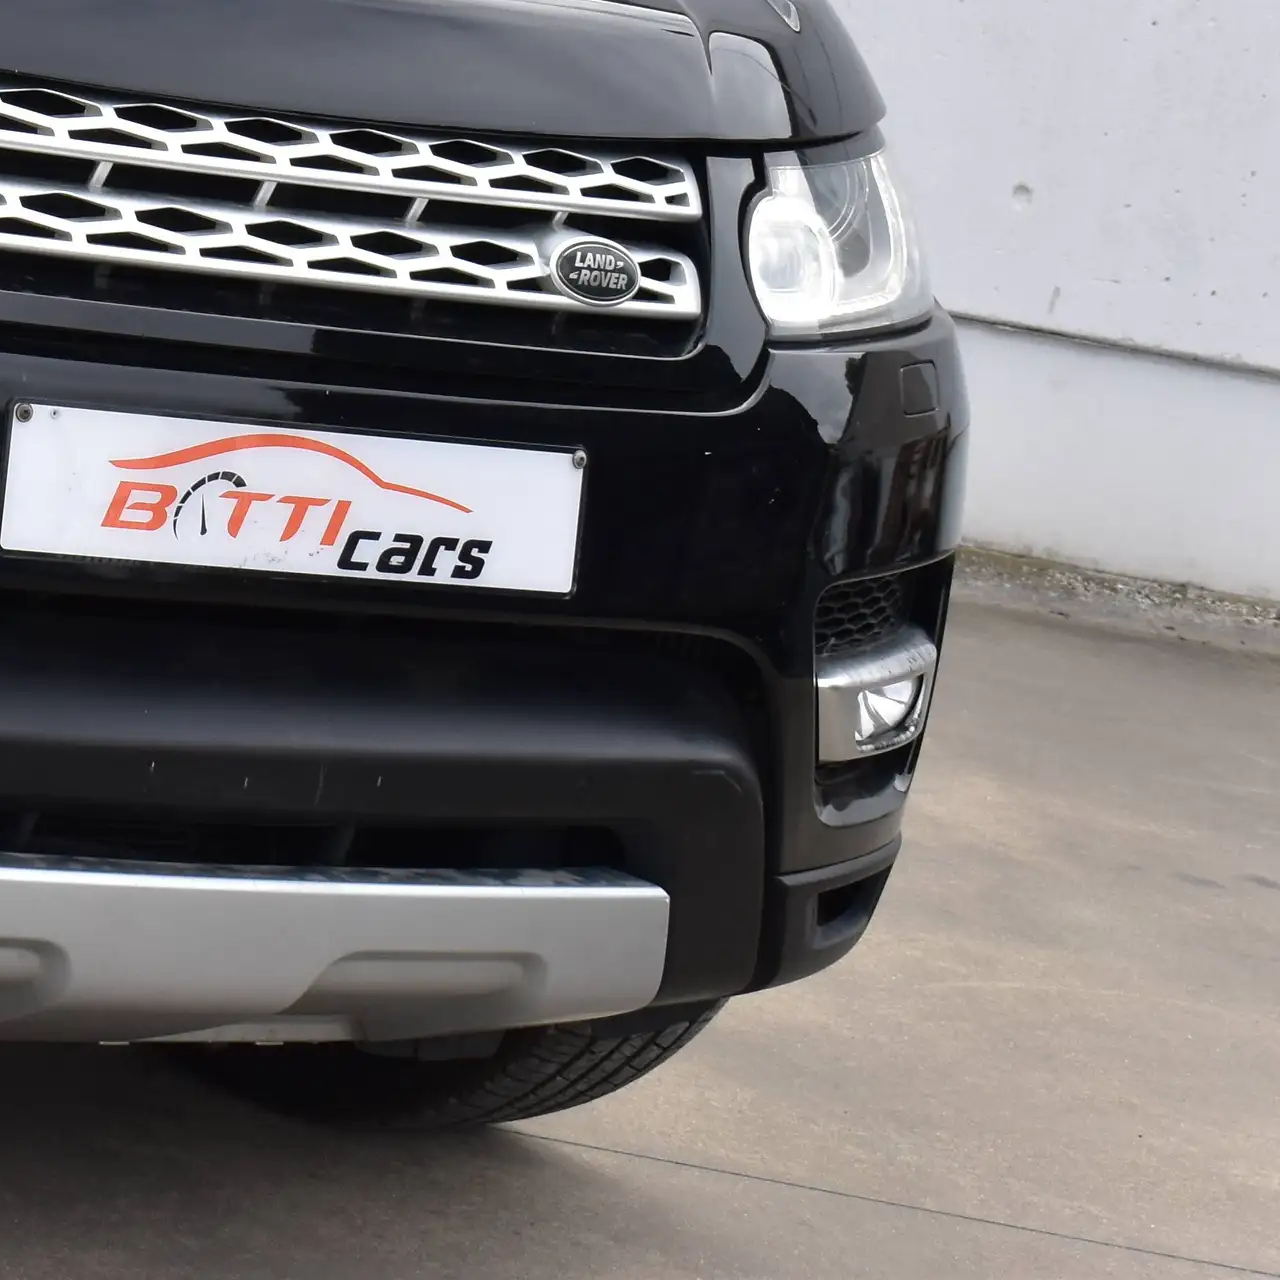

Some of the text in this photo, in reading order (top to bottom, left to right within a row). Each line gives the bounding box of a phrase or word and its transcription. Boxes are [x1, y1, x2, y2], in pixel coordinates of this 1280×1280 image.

[575, 251, 615, 270] LAND
[578, 269, 628, 290] ROVER
[336, 529, 494, 580] cars
